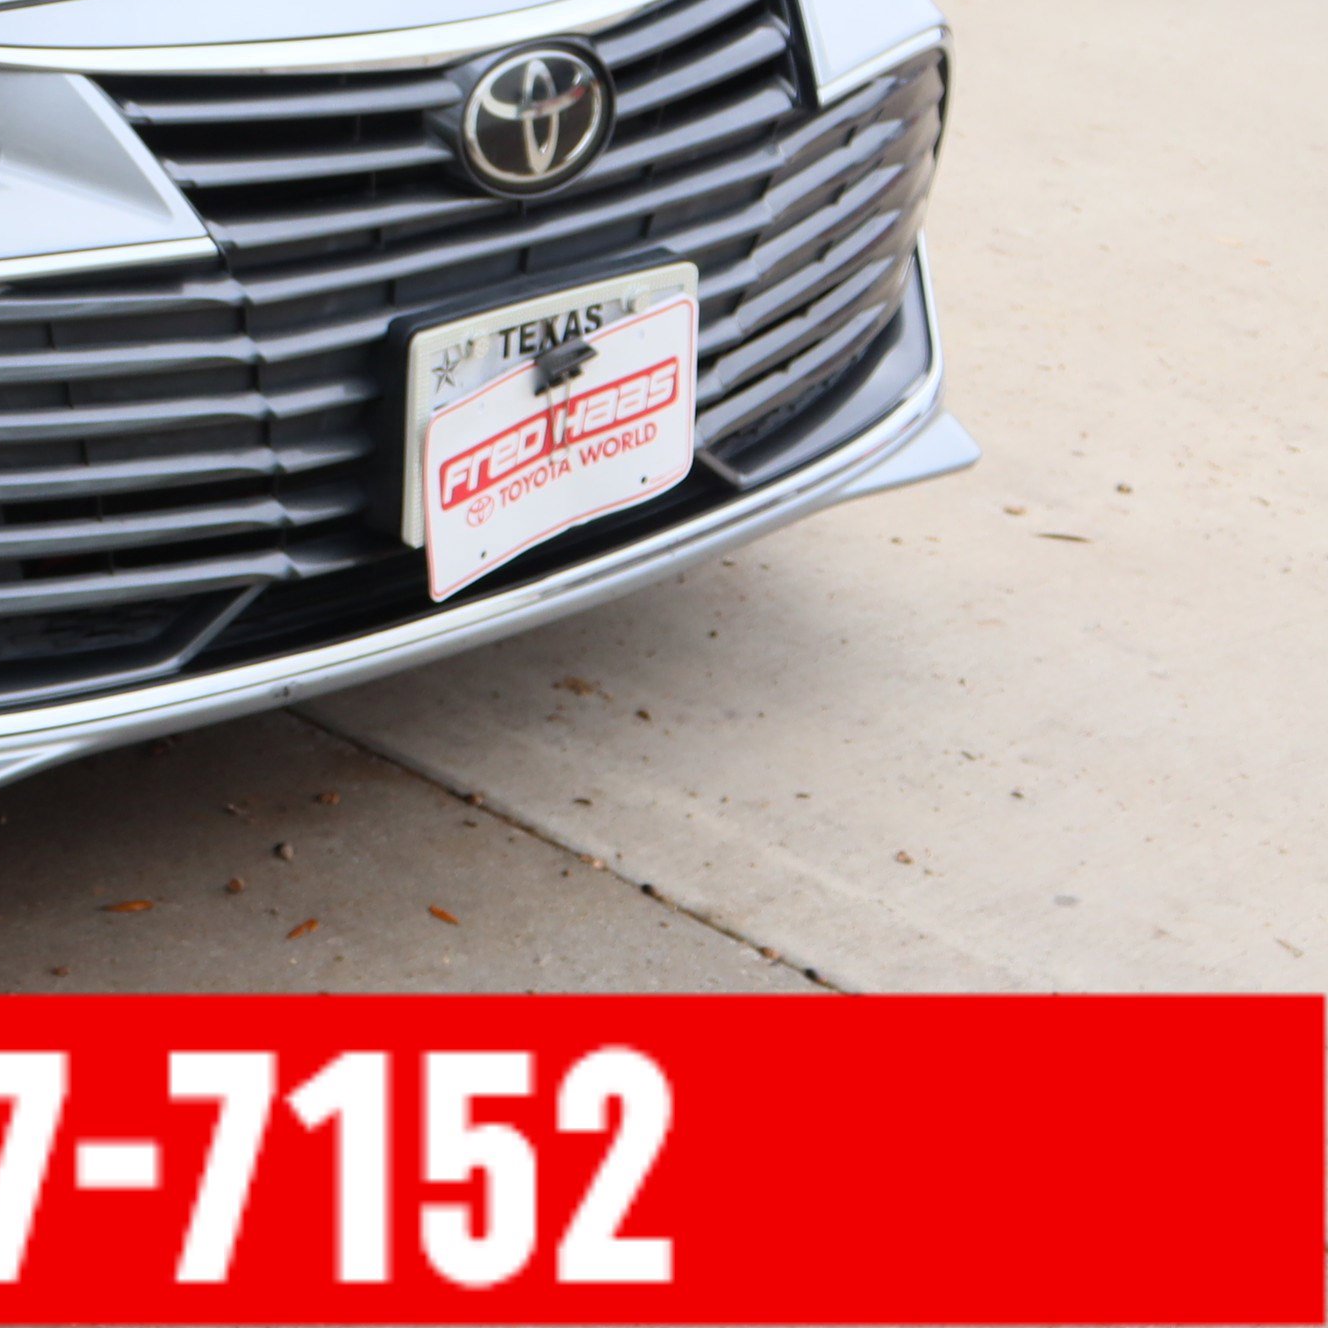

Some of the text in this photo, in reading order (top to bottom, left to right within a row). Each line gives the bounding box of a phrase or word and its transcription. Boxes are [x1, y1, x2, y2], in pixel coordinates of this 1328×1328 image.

[498, 303, 604, 359] TEXAS
[499, 421, 658, 508] TOYOTA WORLD
